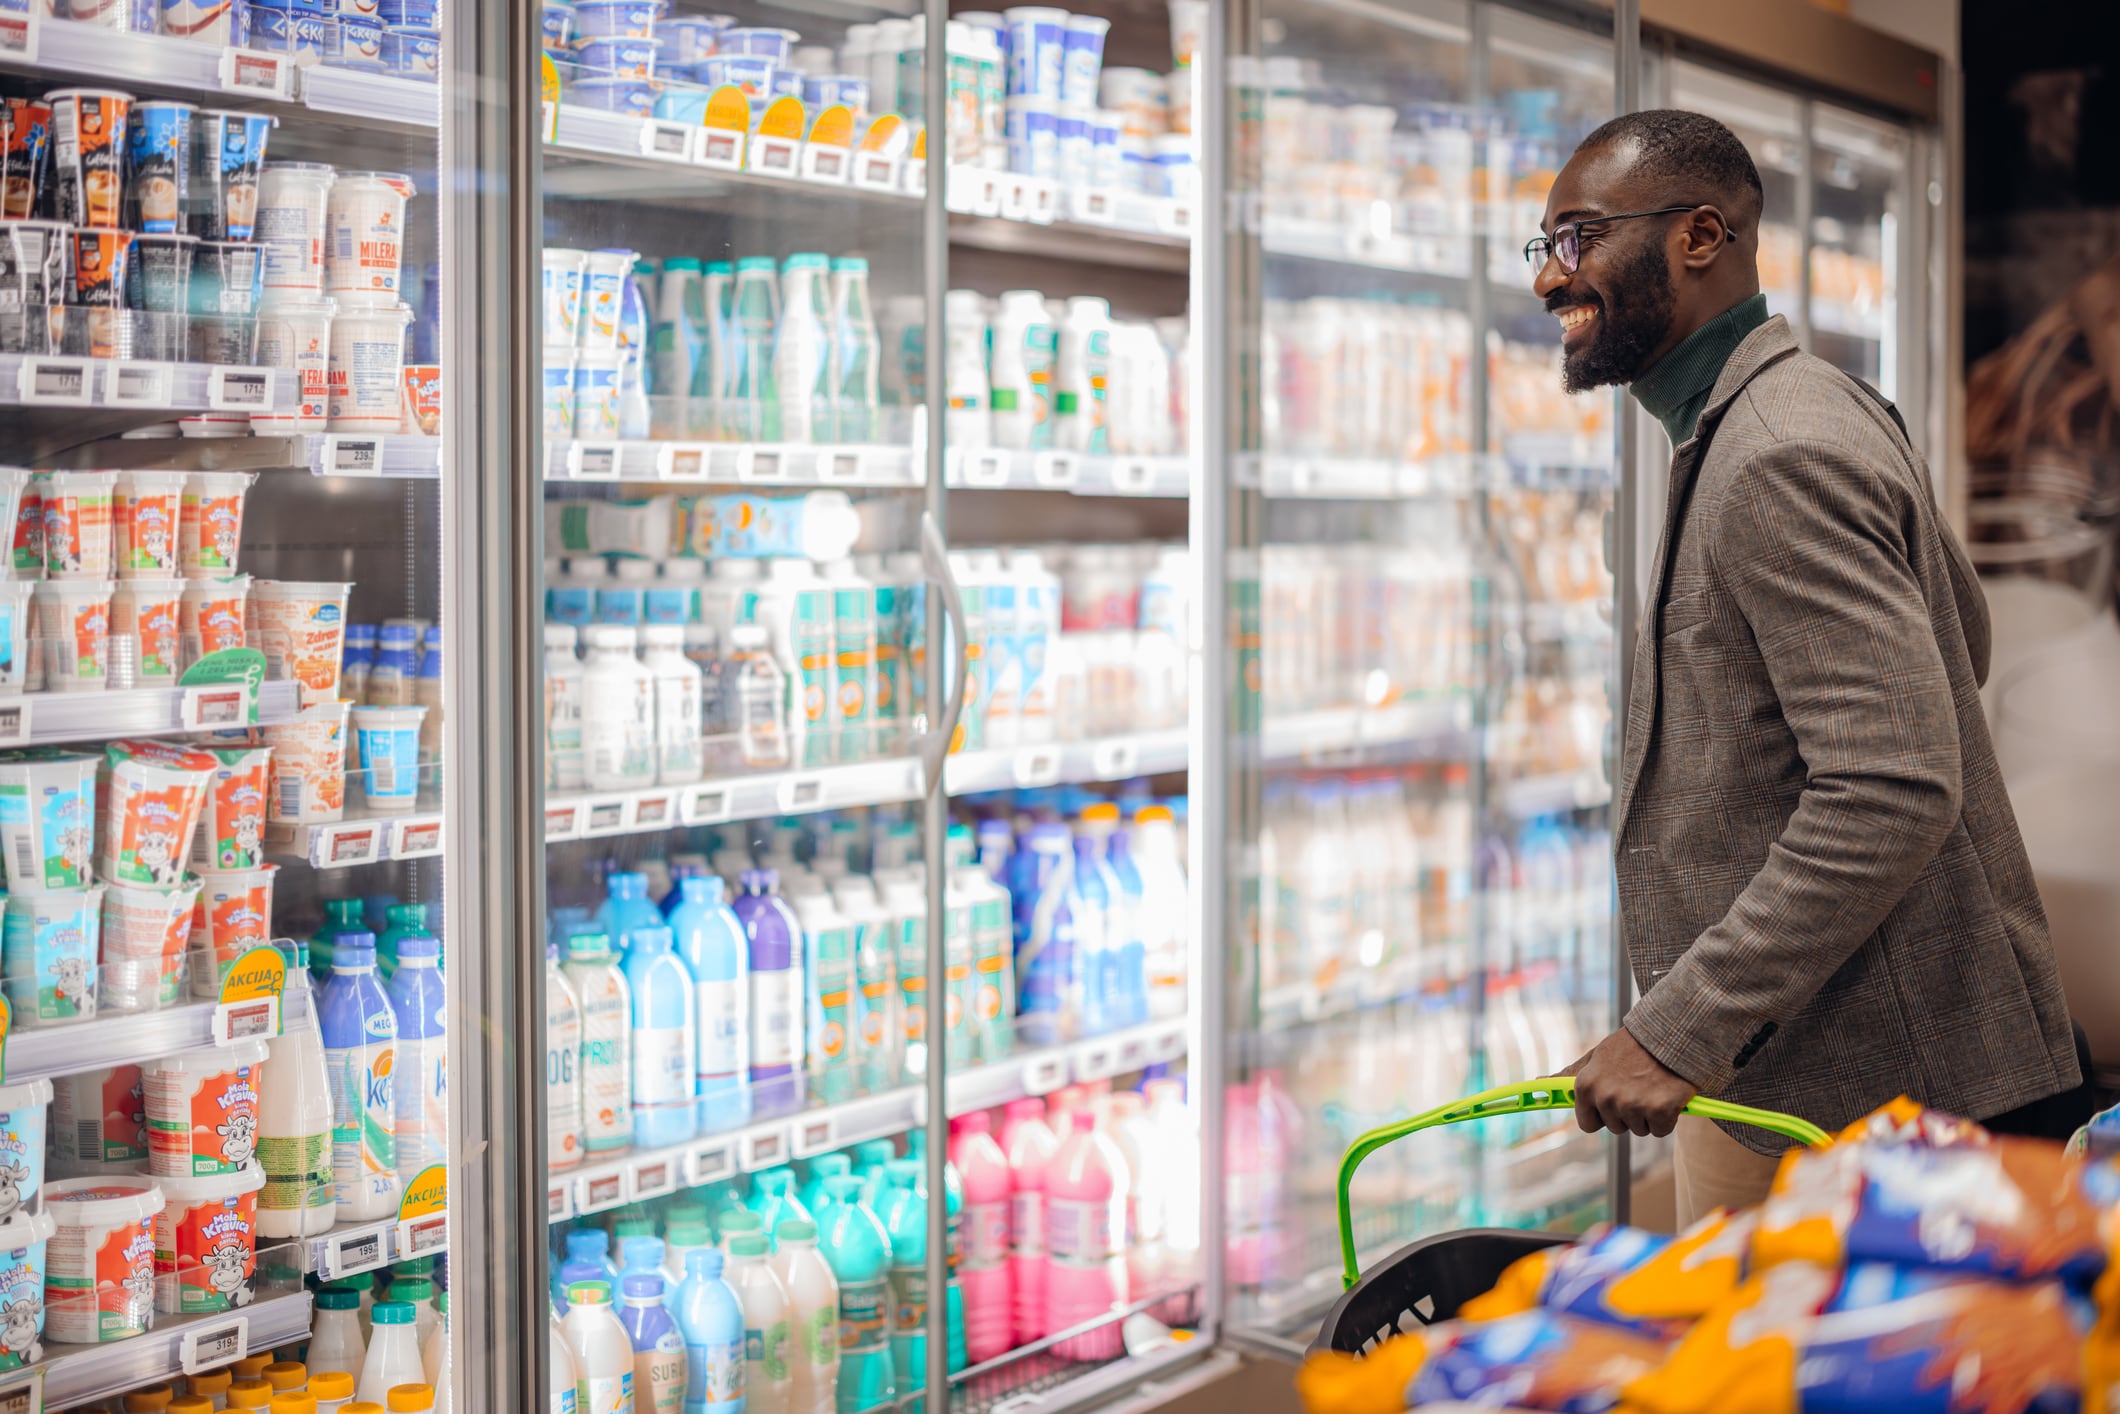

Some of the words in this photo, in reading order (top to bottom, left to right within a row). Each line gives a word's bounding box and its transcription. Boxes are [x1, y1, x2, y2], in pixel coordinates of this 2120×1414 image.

[227, 968, 272, 989] AKCIJA
[228, 1080, 250, 1093] Moja
[217, 1088, 258, 1110] Kravica
[198, 1162, 216, 1172] 700g
[405, 1185, 446, 1207] AKCIJA
[213, 1210, 239, 1225] Moja
[201, 1220, 250, 1240] Kravica
[359, 1244, 373, 1256] 199
[216, 1337, 232, 1351] 319
